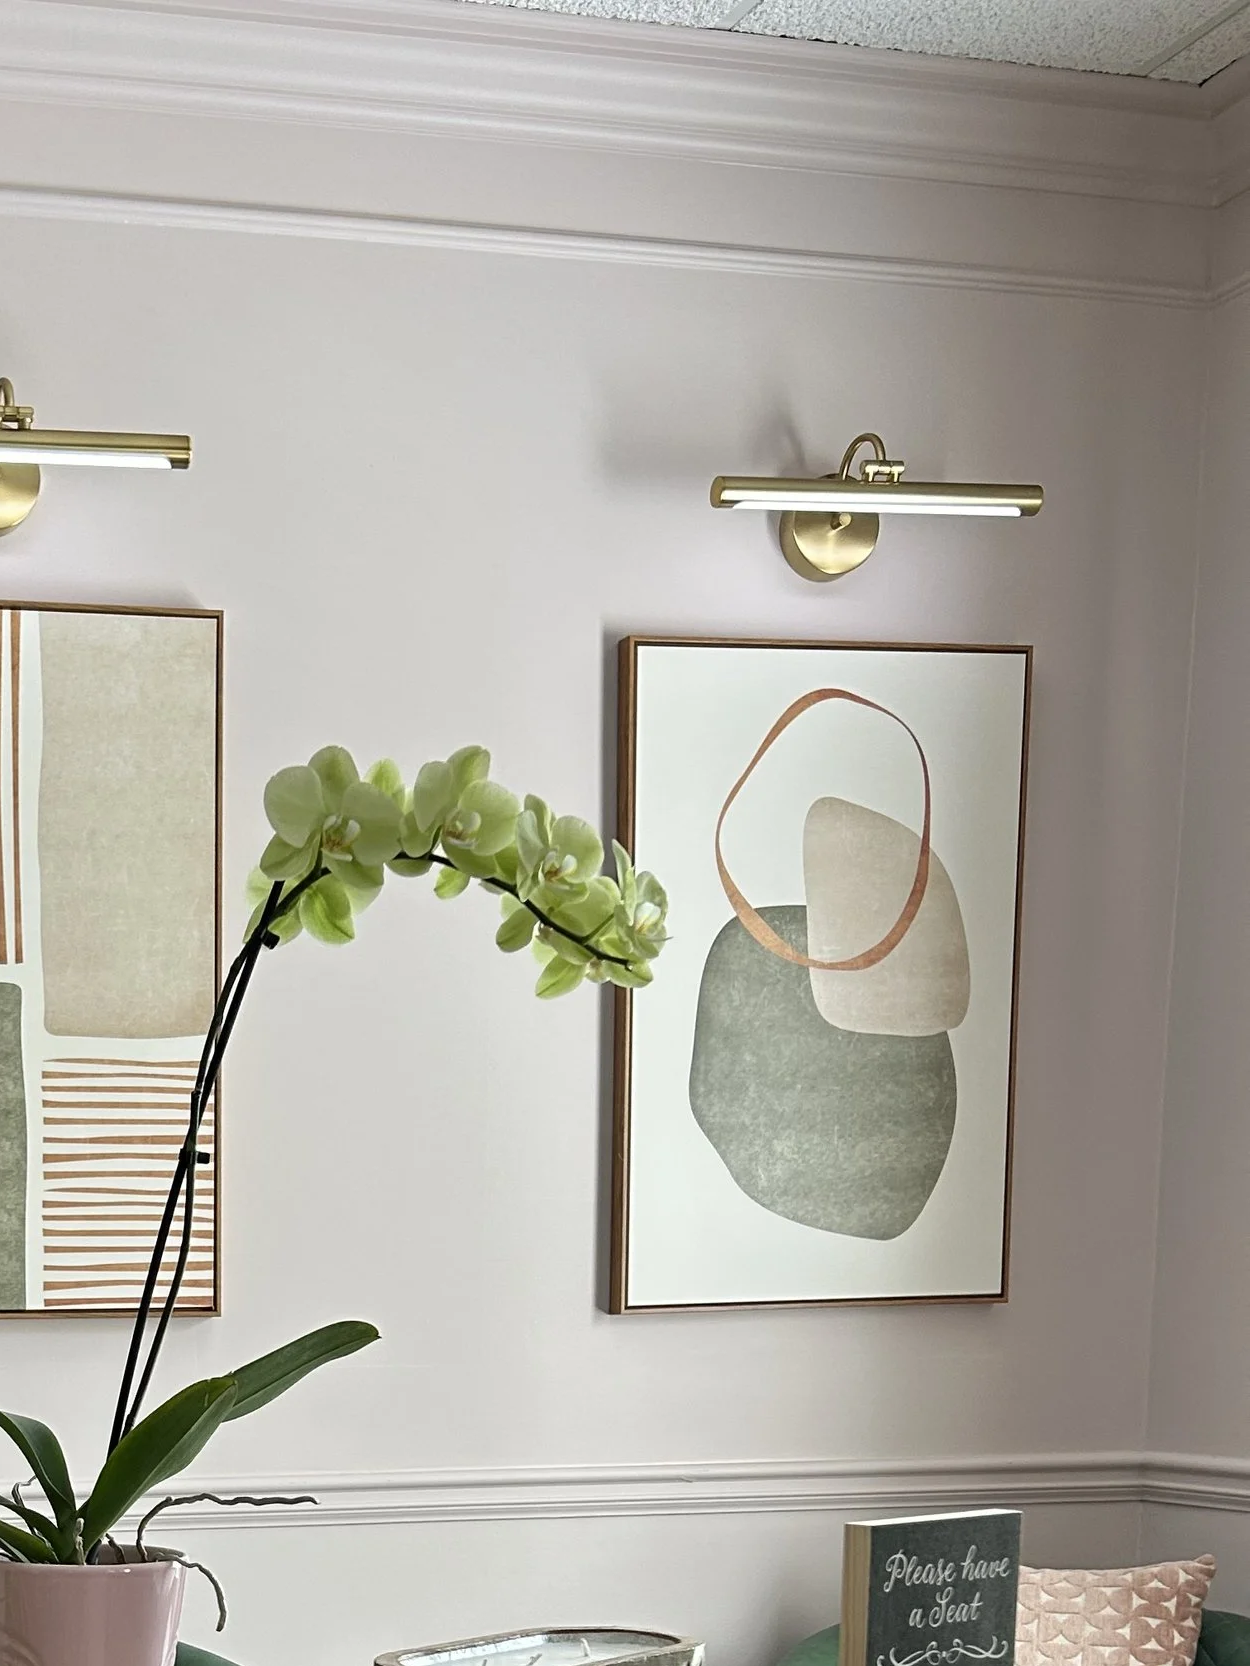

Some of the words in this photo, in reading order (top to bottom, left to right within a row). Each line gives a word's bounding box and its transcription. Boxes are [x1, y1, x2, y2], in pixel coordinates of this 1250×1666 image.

[883, 1549, 957, 1592] Please
[960, 1545, 1010, 1581] have
[909, 1608, 928, 1628] a
[928, 1587, 984, 1628] Seat
